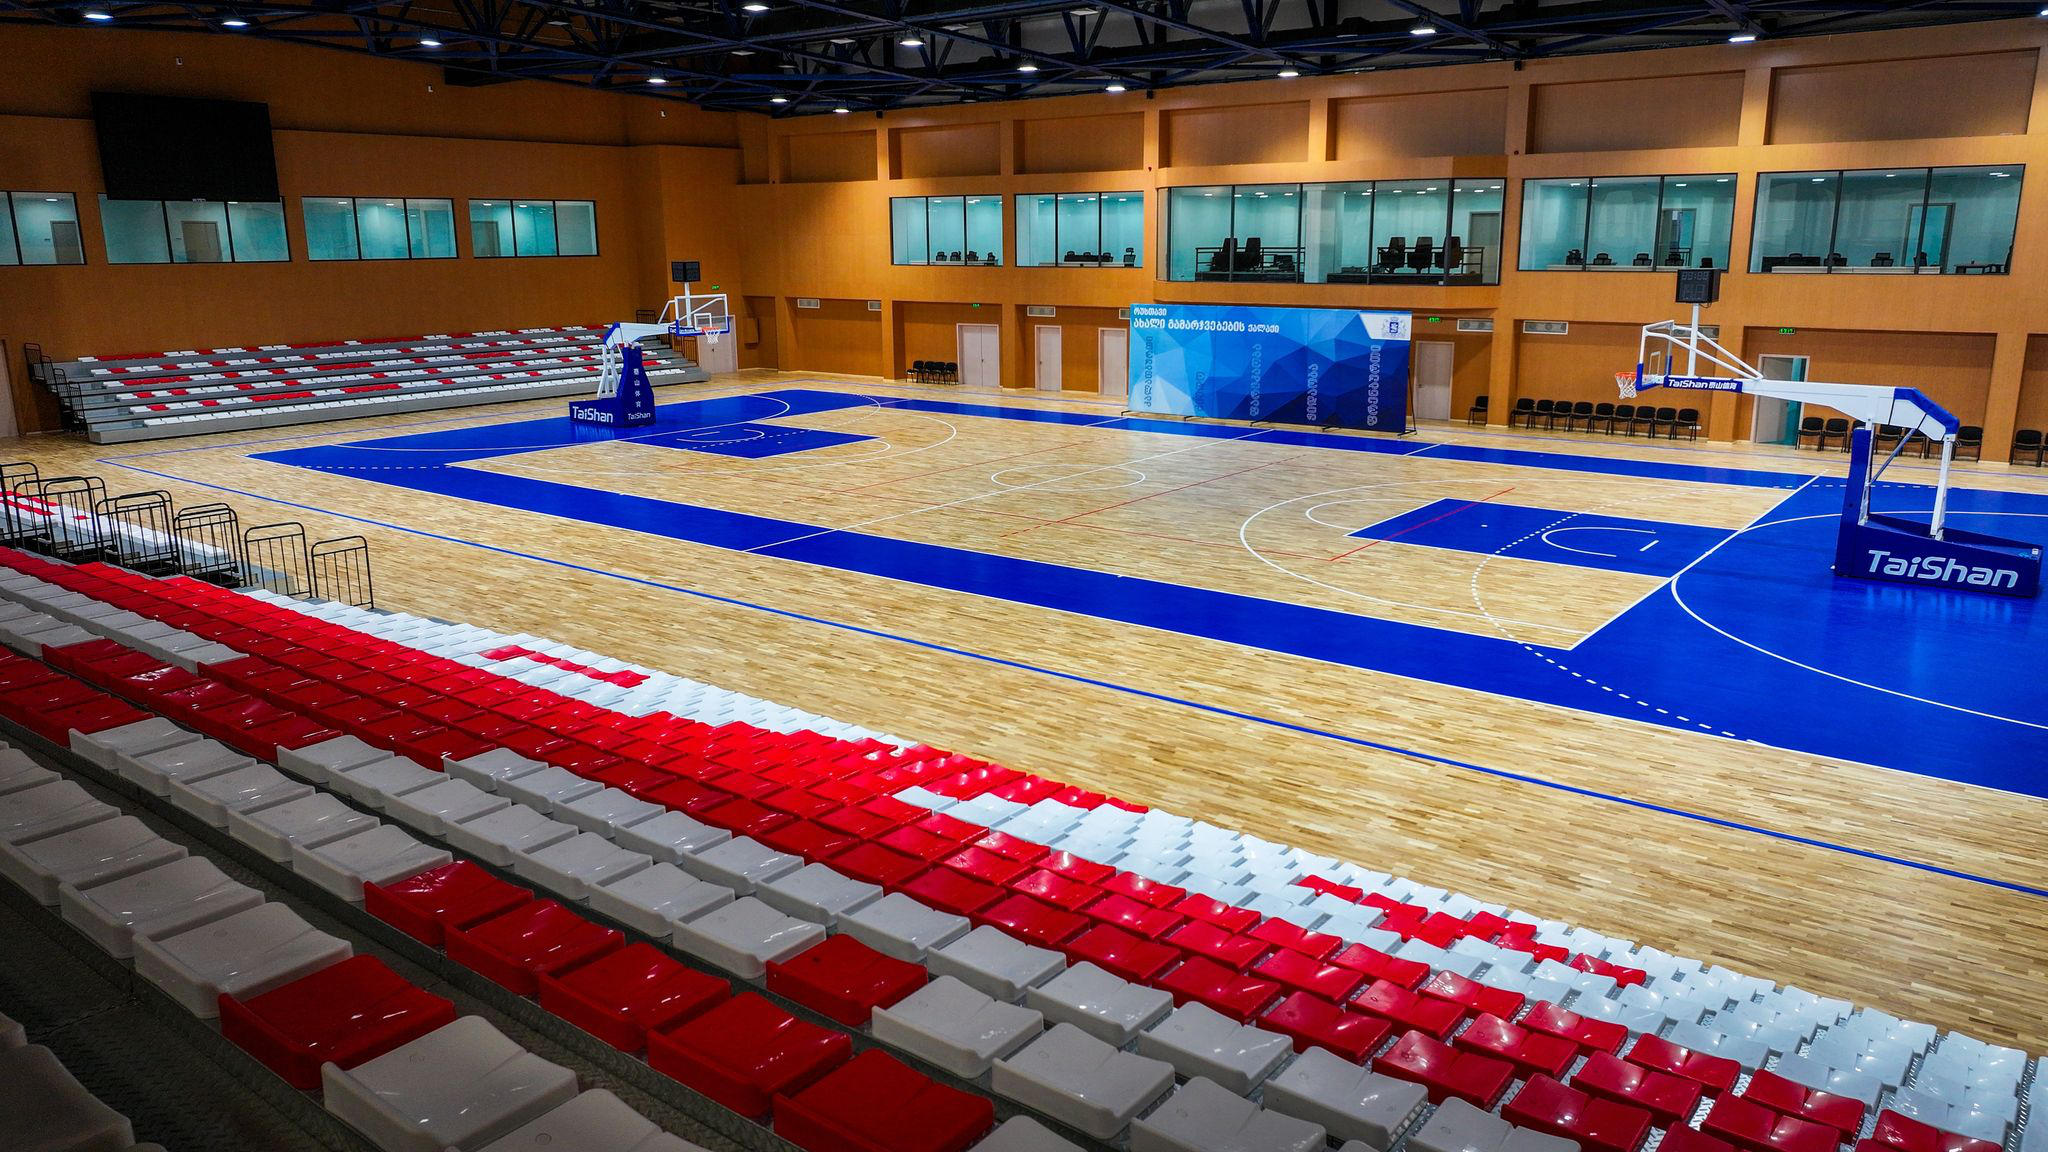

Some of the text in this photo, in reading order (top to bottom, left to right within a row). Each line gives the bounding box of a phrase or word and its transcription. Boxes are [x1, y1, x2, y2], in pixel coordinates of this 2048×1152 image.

[1134, 307, 1167, 316] რუსთავი
[1134, 318, 1280, 333] ახალი გამარჯვებების ქალაქი
[1367, 344, 1382, 427] ფრენბურთი
[1668, 379, 1709, 389] TaiShan
[572, 405, 614, 423] TaiShan
[627, 411, 651, 421] TaiShan
[1868, 549, 2019, 588] TaiShan
